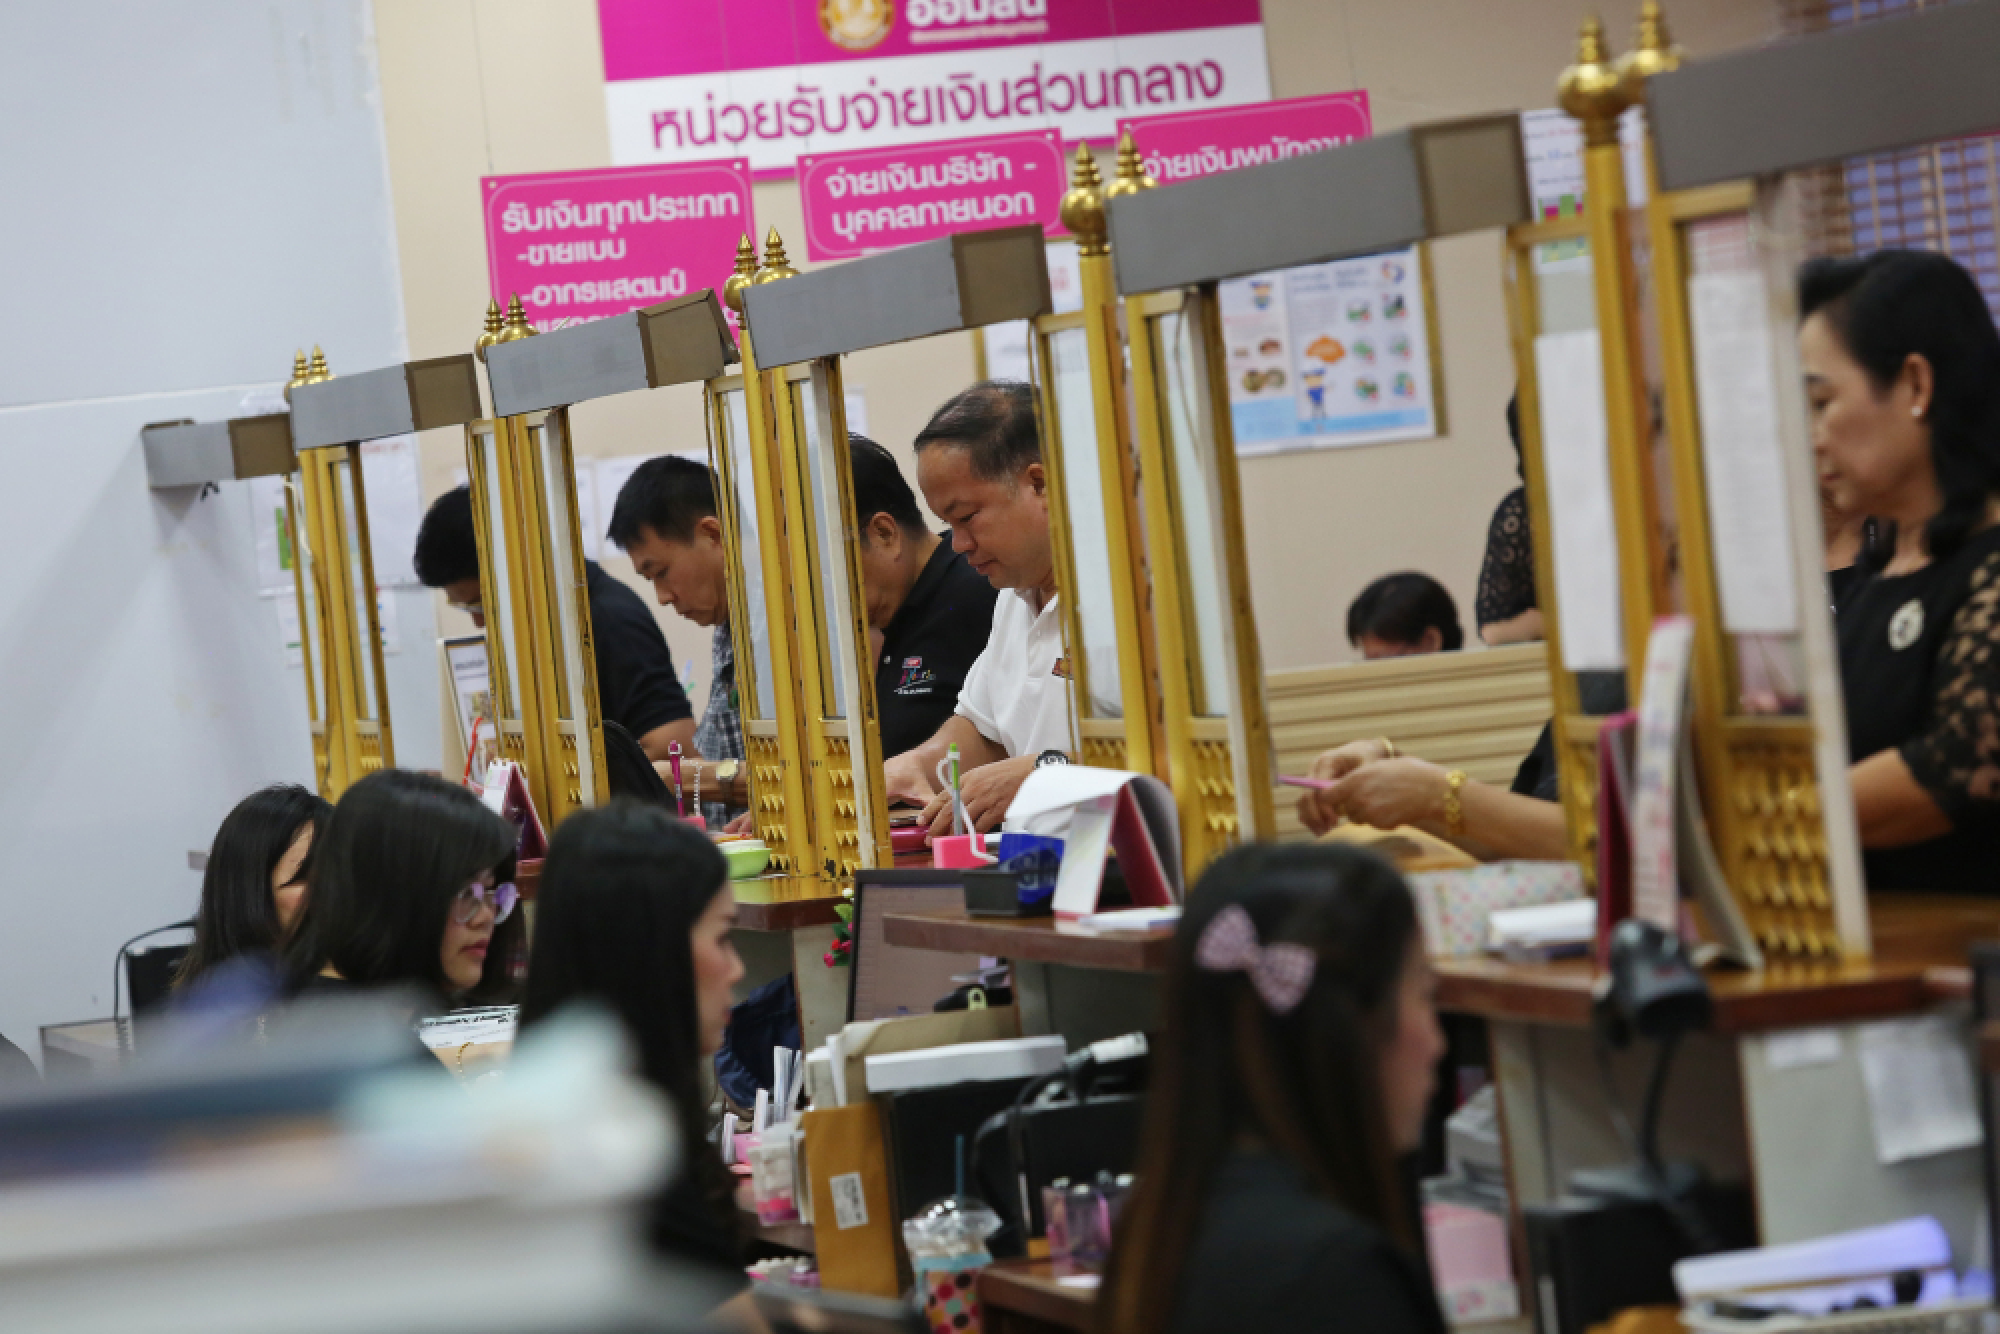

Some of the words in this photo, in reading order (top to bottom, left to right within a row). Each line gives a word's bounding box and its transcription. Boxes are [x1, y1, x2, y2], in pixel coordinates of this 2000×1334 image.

[905, 0, 1049, 27] ออมสน
[651, 58, 1223, 149] หน่วยรับจ่ายเงินส่วนกลาง
[826, 152, 1013, 198] จ่ายเงินบริษัท
[502, 191, 740, 233] รับเงินทุกประเภท
[832, 191, 1036, 242] บุคคลภายนอก
